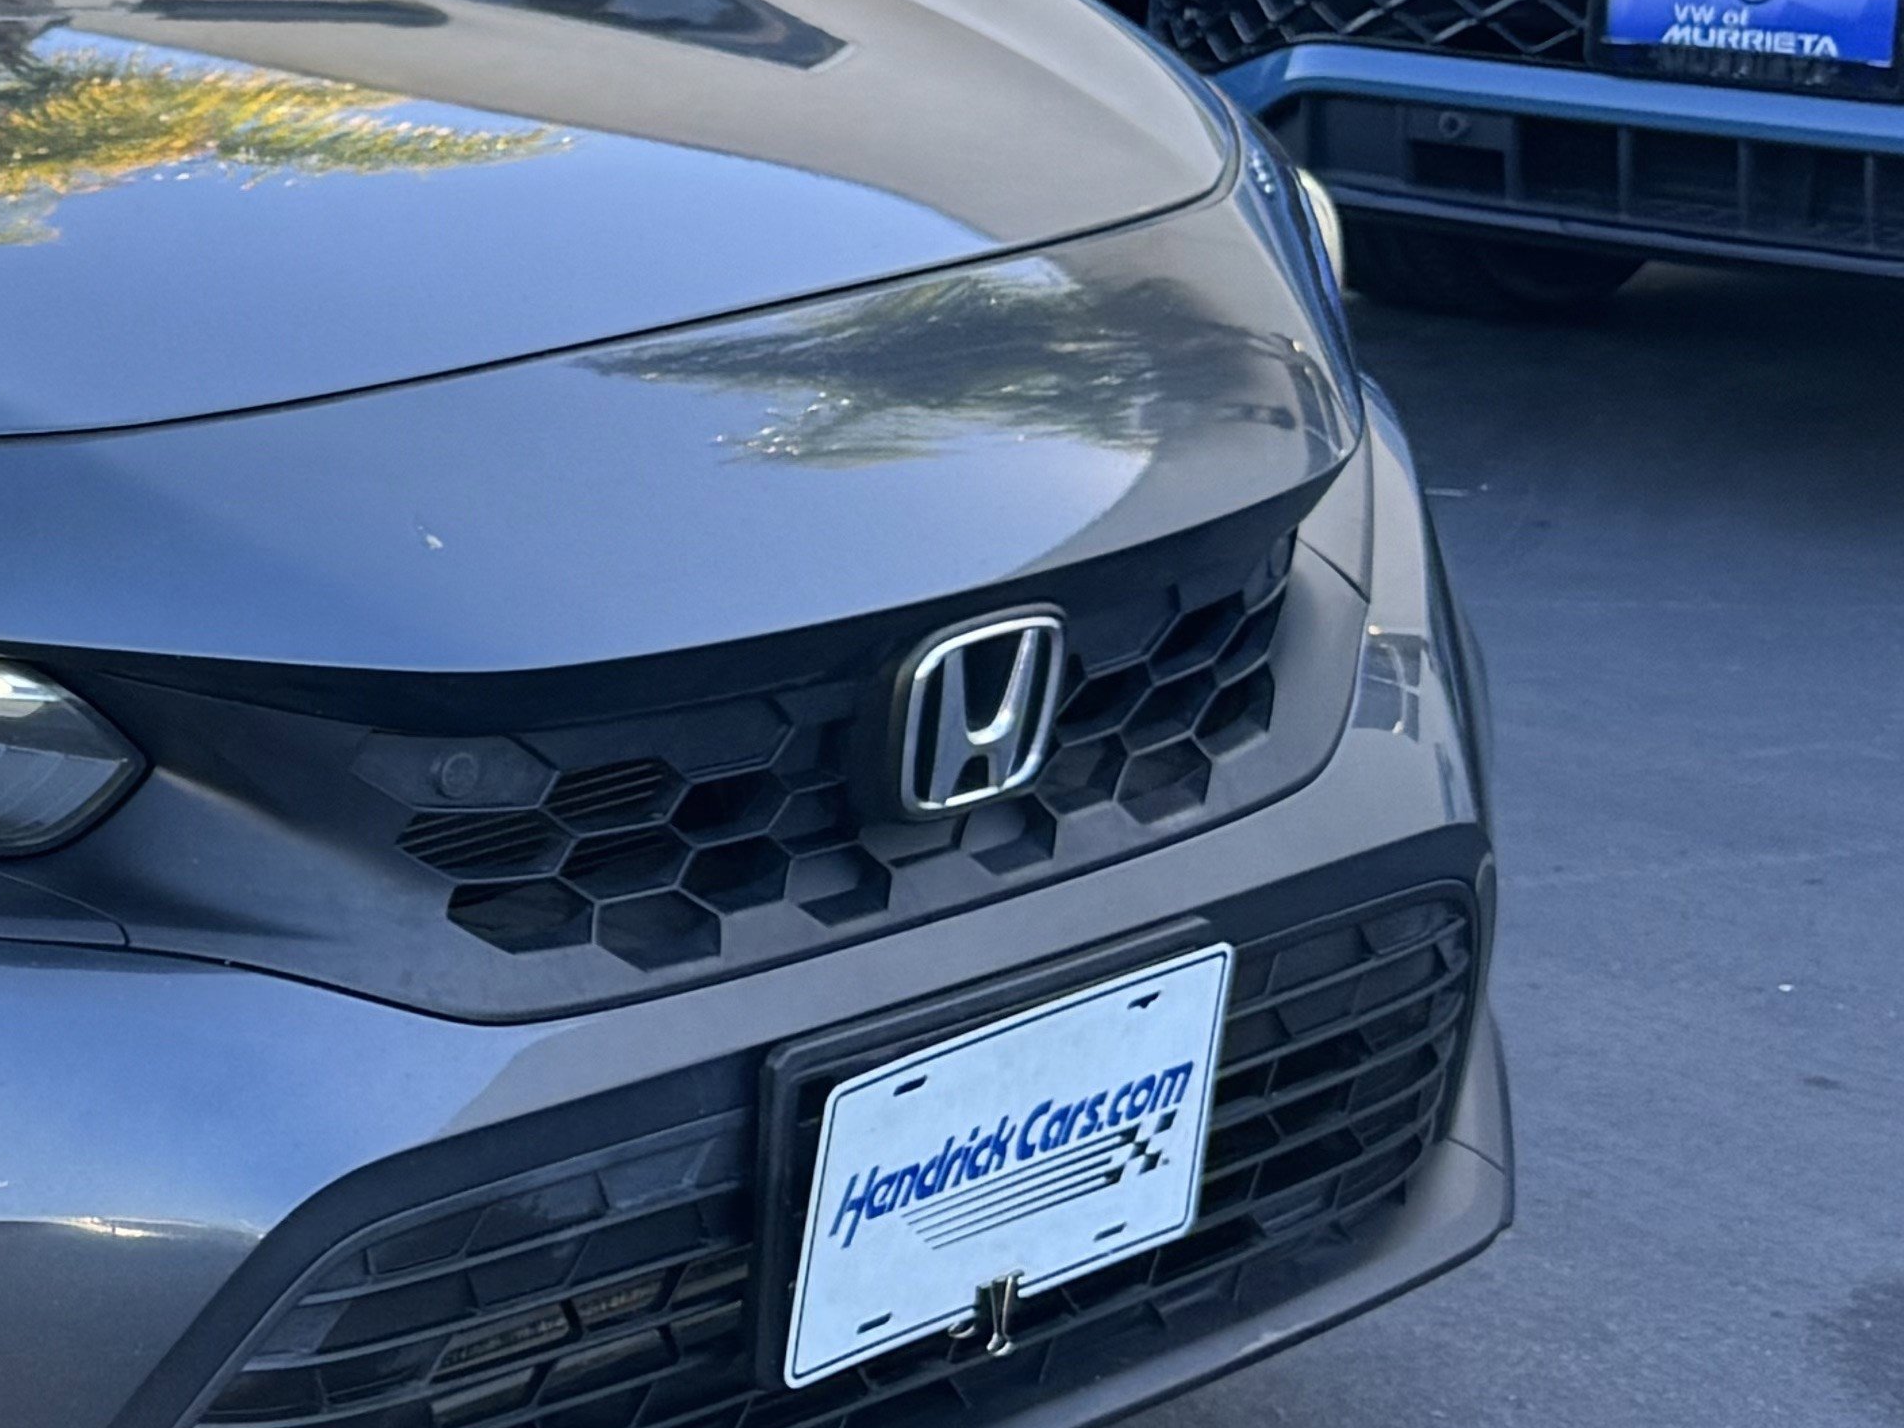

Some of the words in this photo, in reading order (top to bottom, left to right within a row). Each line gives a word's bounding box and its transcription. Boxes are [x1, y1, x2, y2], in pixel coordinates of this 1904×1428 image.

[1674, 2, 1715, 25] VW
[1722, 7, 1749, 27] of
[1661, 24, 1839, 58] MURRIETA
